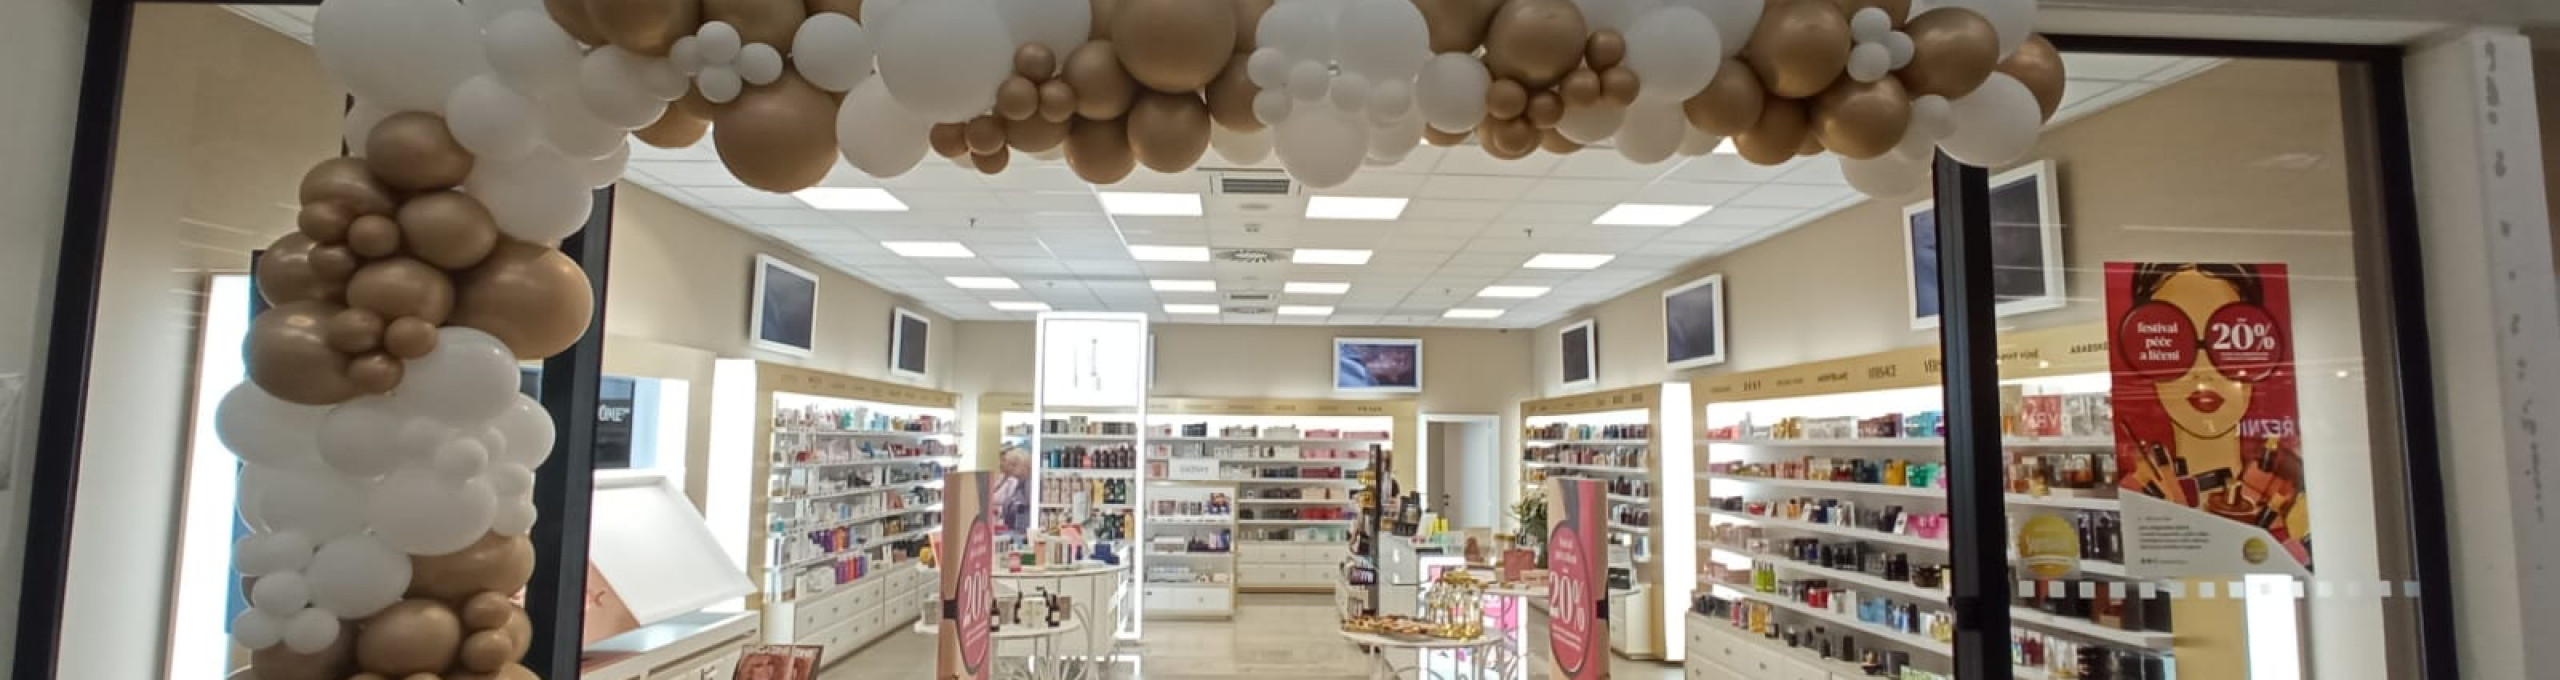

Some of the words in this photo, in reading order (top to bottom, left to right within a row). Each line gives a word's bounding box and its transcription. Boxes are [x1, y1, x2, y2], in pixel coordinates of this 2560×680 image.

[2137, 321, 2178, 334] festival
[2145, 336, 2173, 349] péče
[2211, 322, 2276, 351] 20%
[2139, 352, 2147, 361] a
[2149, 347, 2179, 361] líčení
[1869, 364, 1896, 379] VERSACE
[1548, 571, 1585, 633] 20%
